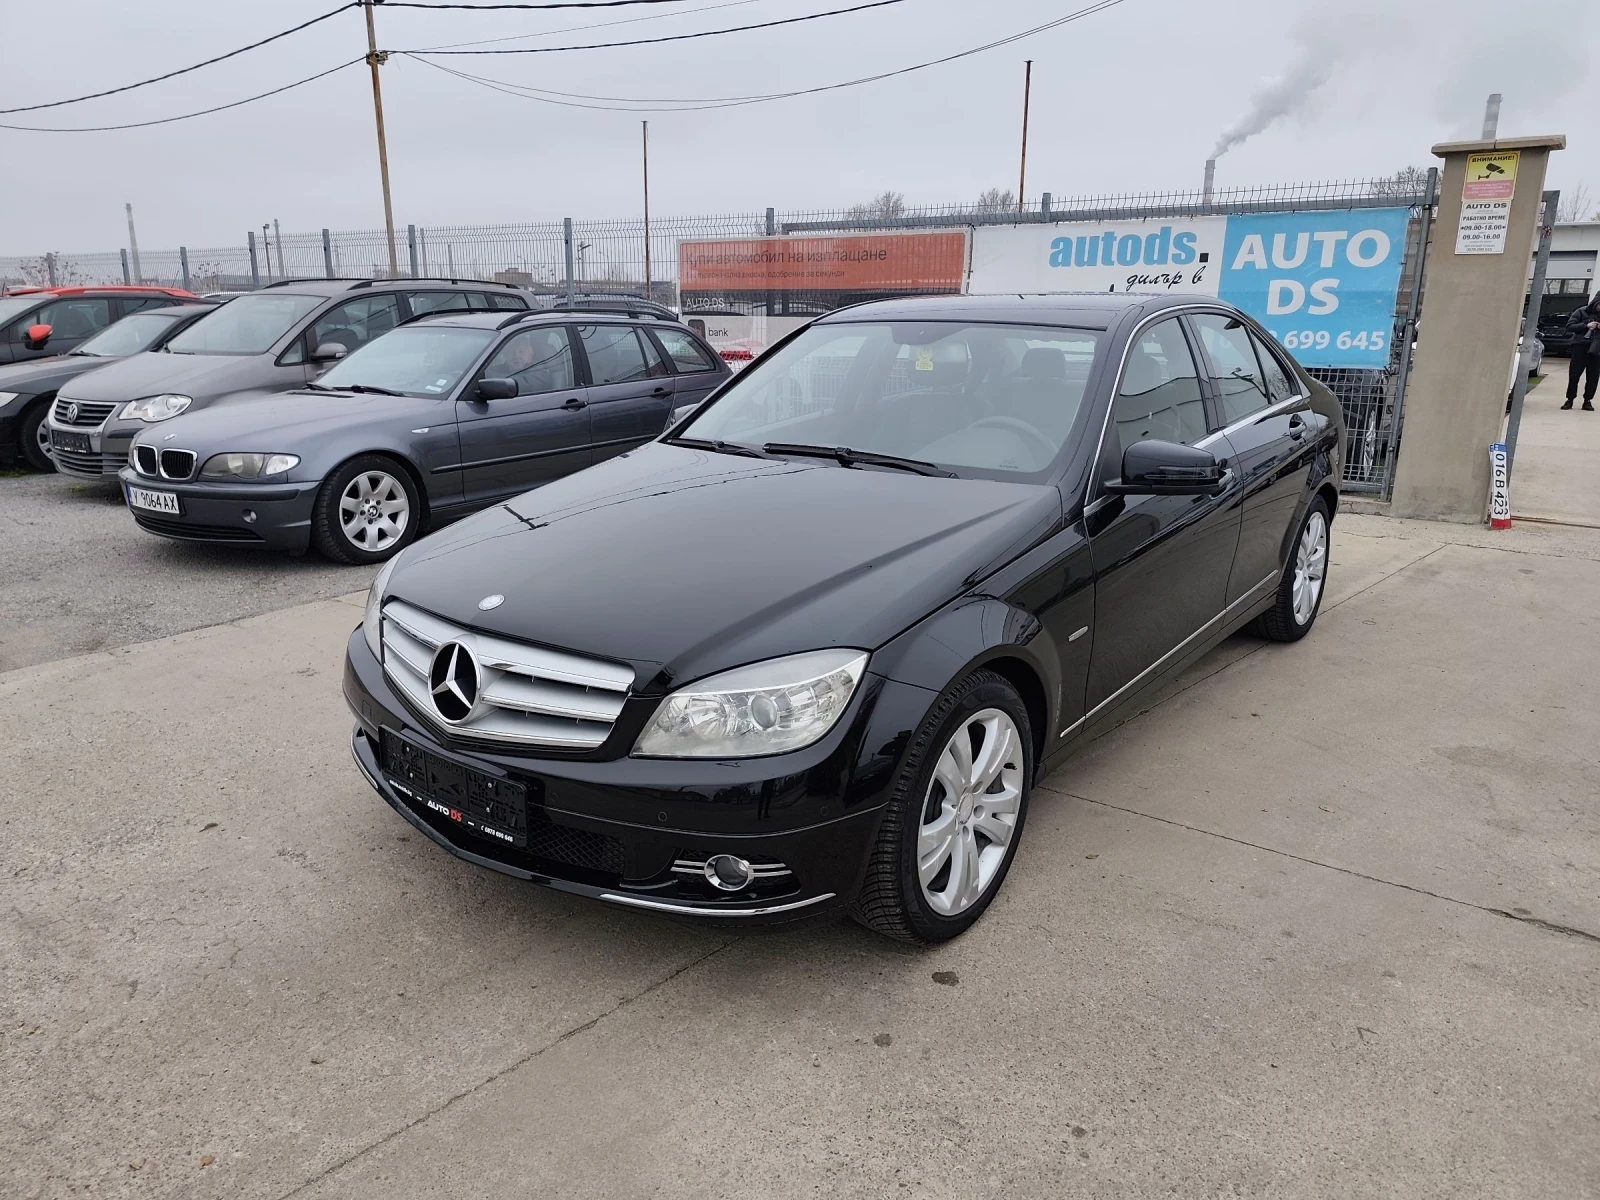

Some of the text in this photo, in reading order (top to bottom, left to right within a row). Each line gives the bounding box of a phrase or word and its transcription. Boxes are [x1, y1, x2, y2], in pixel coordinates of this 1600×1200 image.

[1471, 155, 1515, 163] ВНИМАНИЕ!
[716, 250, 784, 264] автомобил
[788, 252, 804, 263] на
[807, 249, 887, 264] изплащане
[1230, 229, 1391, 270] AUTO
[1126, 265, 1207, 292] дилър в
[686, 297, 725, 308] AUTO DS
[1266, 278, 1340, 315] DS
[708, 327, 729, 337] bank
[1283, 330, 1331, 350] 699
[1336, 330, 1385, 351] 645
[163, 495, 177, 511] AX
[427, 799, 450, 816] AUTO
[450, 808, 463, 822] DS
